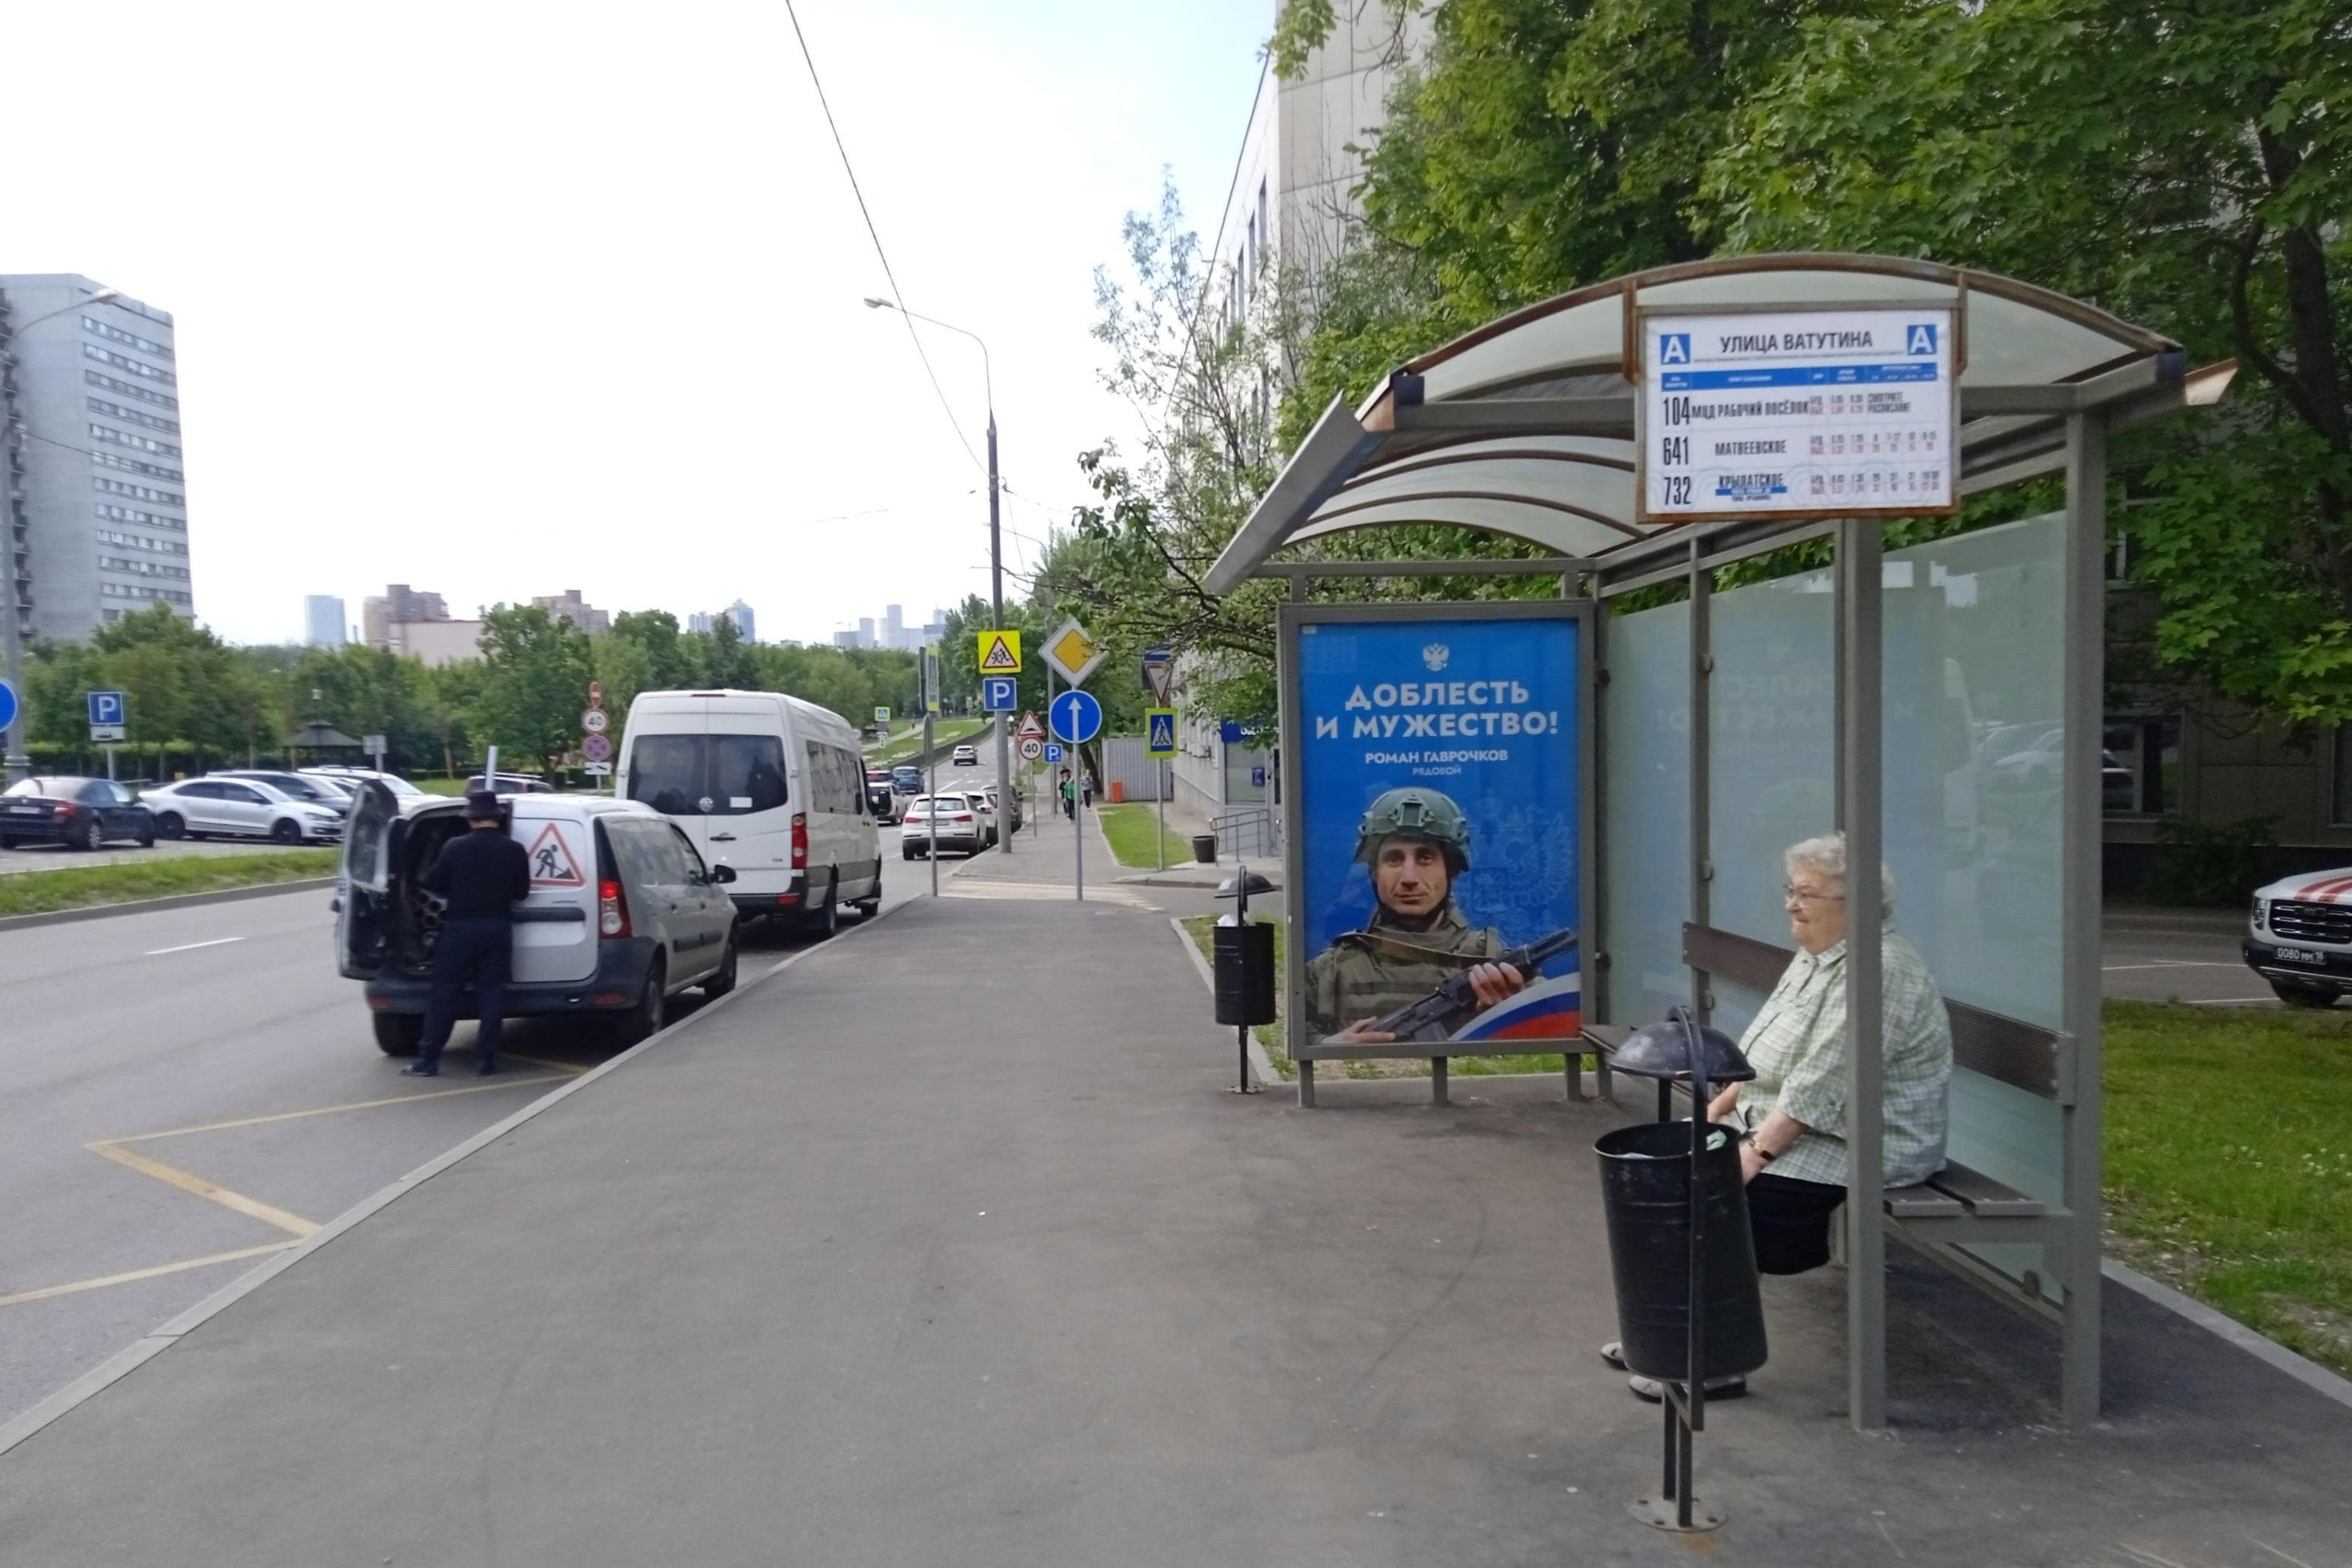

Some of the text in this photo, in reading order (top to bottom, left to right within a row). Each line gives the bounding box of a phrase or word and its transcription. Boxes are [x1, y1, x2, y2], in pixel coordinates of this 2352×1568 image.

[1663, 335, 1687, 363] А
[1720, 330, 1873, 354] УЛИЦА ВАТУТИНА
[1909, 326, 1934, 354] А
[1663, 397, 1691, 426] 104
[1718, 401, 1762, 417] РАБОЧИЙ
[1765, 399, 1808, 415] ПОСЁЛОК
[1663, 436, 1689, 466] 641
[1715, 440, 1787, 456] МАТВЕЕВСКОЕ
[1664, 476, 1691, 505] 732
[1719, 473, 1784, 488] КРЫЛАТСКОЕ
[993, 681, 1010, 707] P
[1345, 681, 1530, 711] ДОБЛЕСТЬ
[98, 696, 116, 721] P
[1316, 711, 1558, 740] И МУЖЕСТВО!
[1024, 743, 1038, 753] 40
[1049, 746, 1059, 761] P
[1365, 749, 1508, 764] РОМАН ГАВРОЧКОВ
[1412, 764, 1462, 776] РЯДОВОЙ
